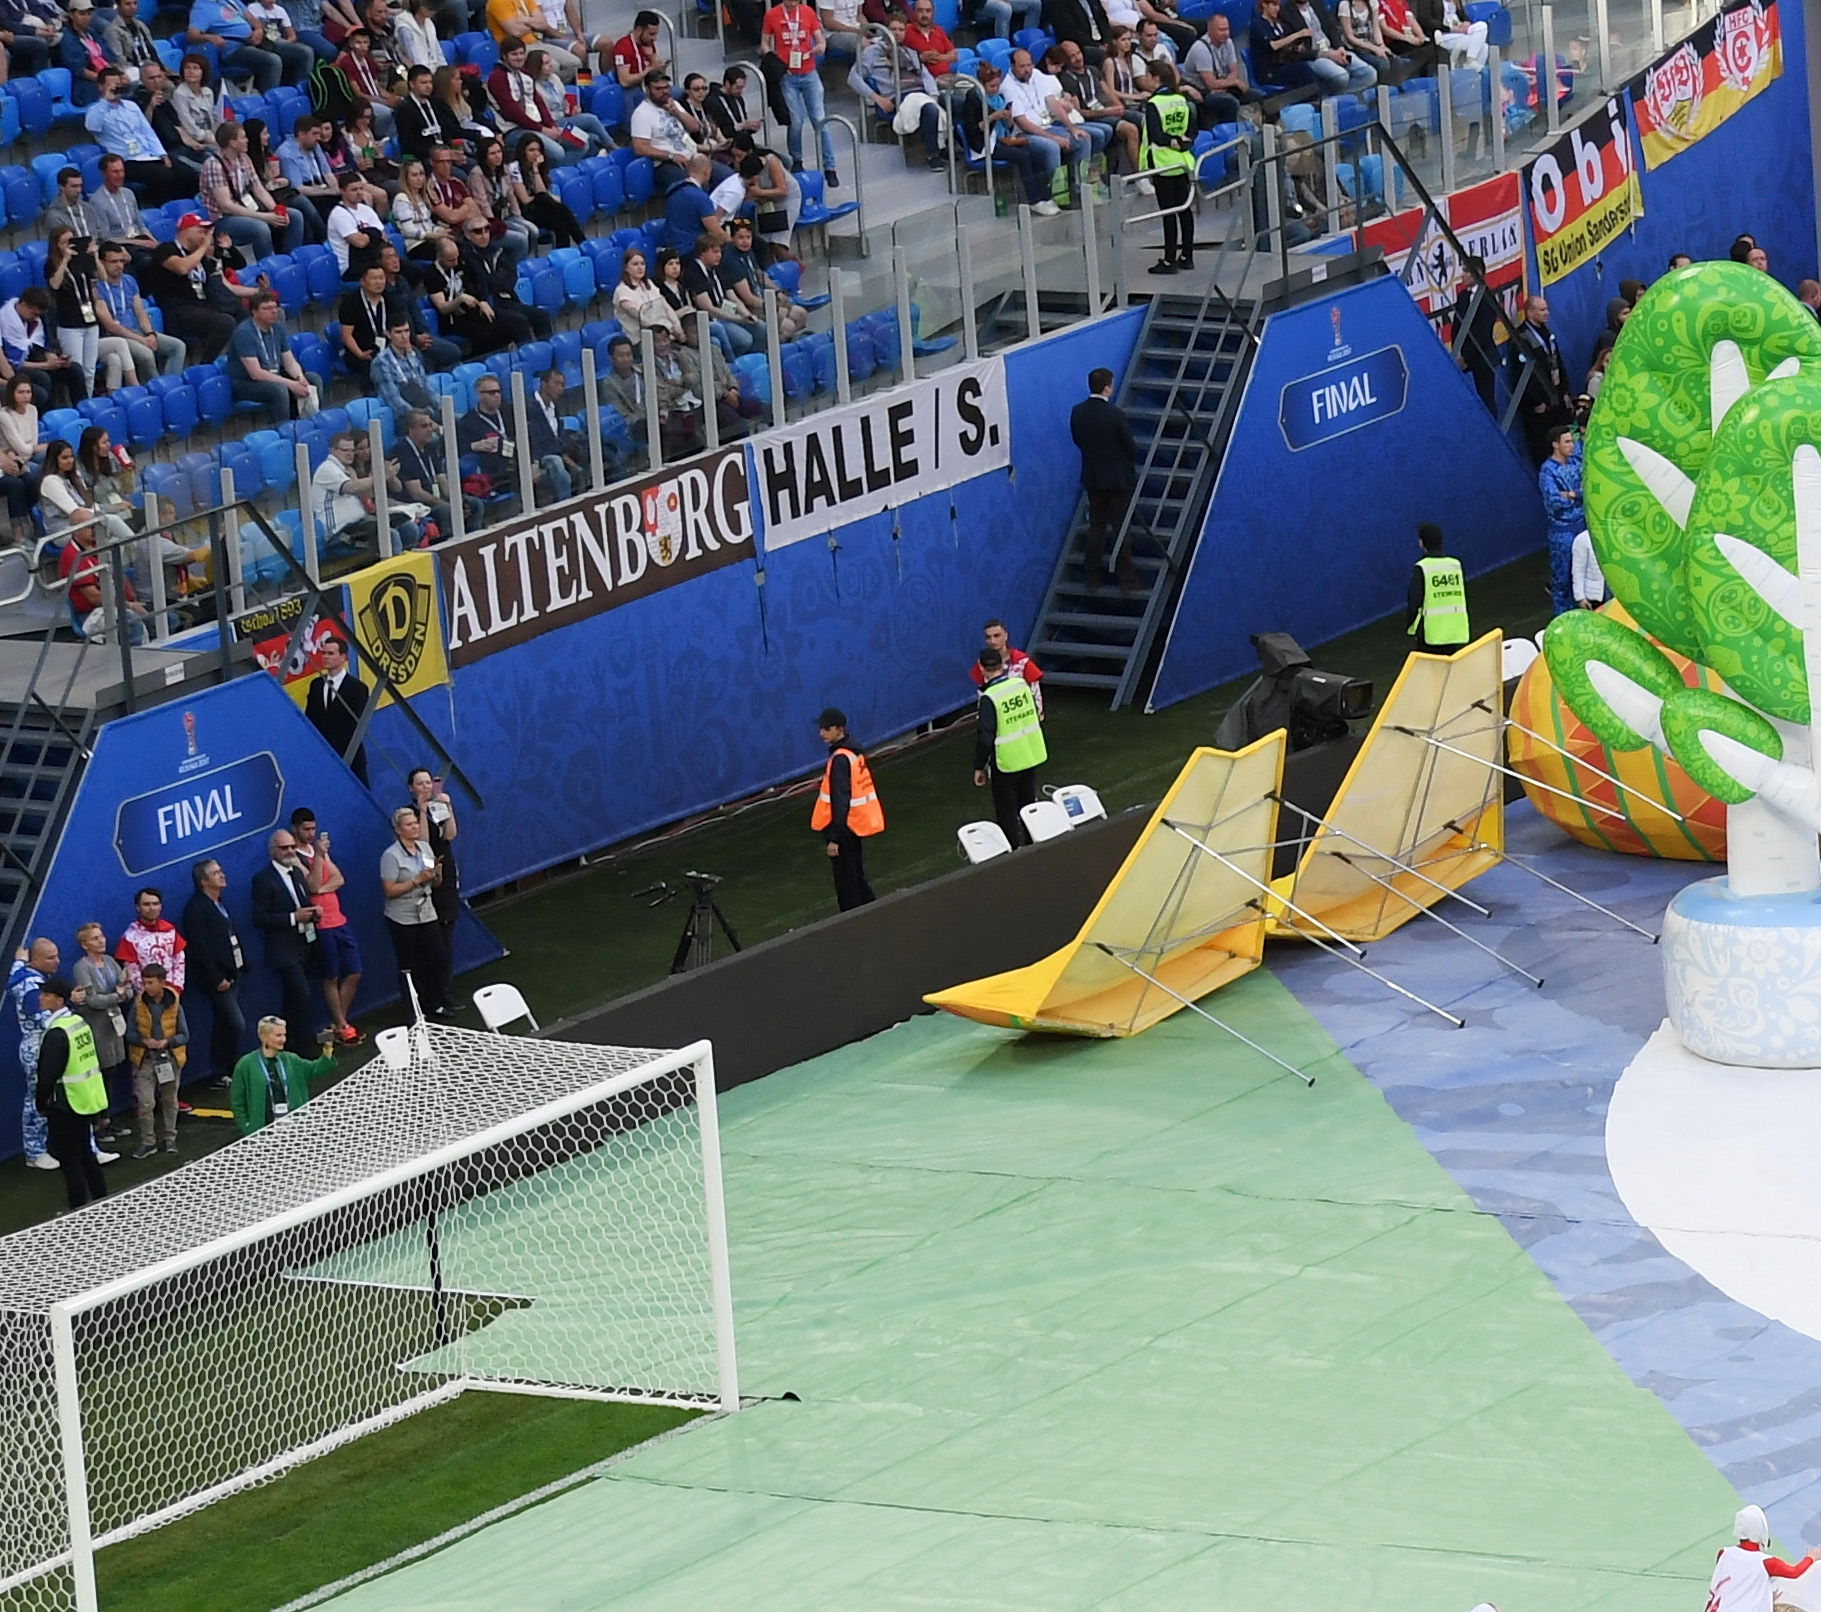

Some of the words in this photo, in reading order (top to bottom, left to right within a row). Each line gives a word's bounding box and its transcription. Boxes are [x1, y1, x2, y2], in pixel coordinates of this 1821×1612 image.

[1728, 10, 1749, 29] HFC
[1458, 222, 1517, 266] ERLIN
[1542, 245, 1559, 276] SG
[1559, 230, 1587, 267] Union
[1311, 372, 1378, 424] FINAL
[763, 400, 919, 527] HALLE
[956, 377, 1000, 456] S.
[1431, 574, 1460, 587] 6461
[370, 623, 426, 685] DRESDEN
[1001, 691, 1029, 714] 3561
[157, 784, 242, 844] FINAL
